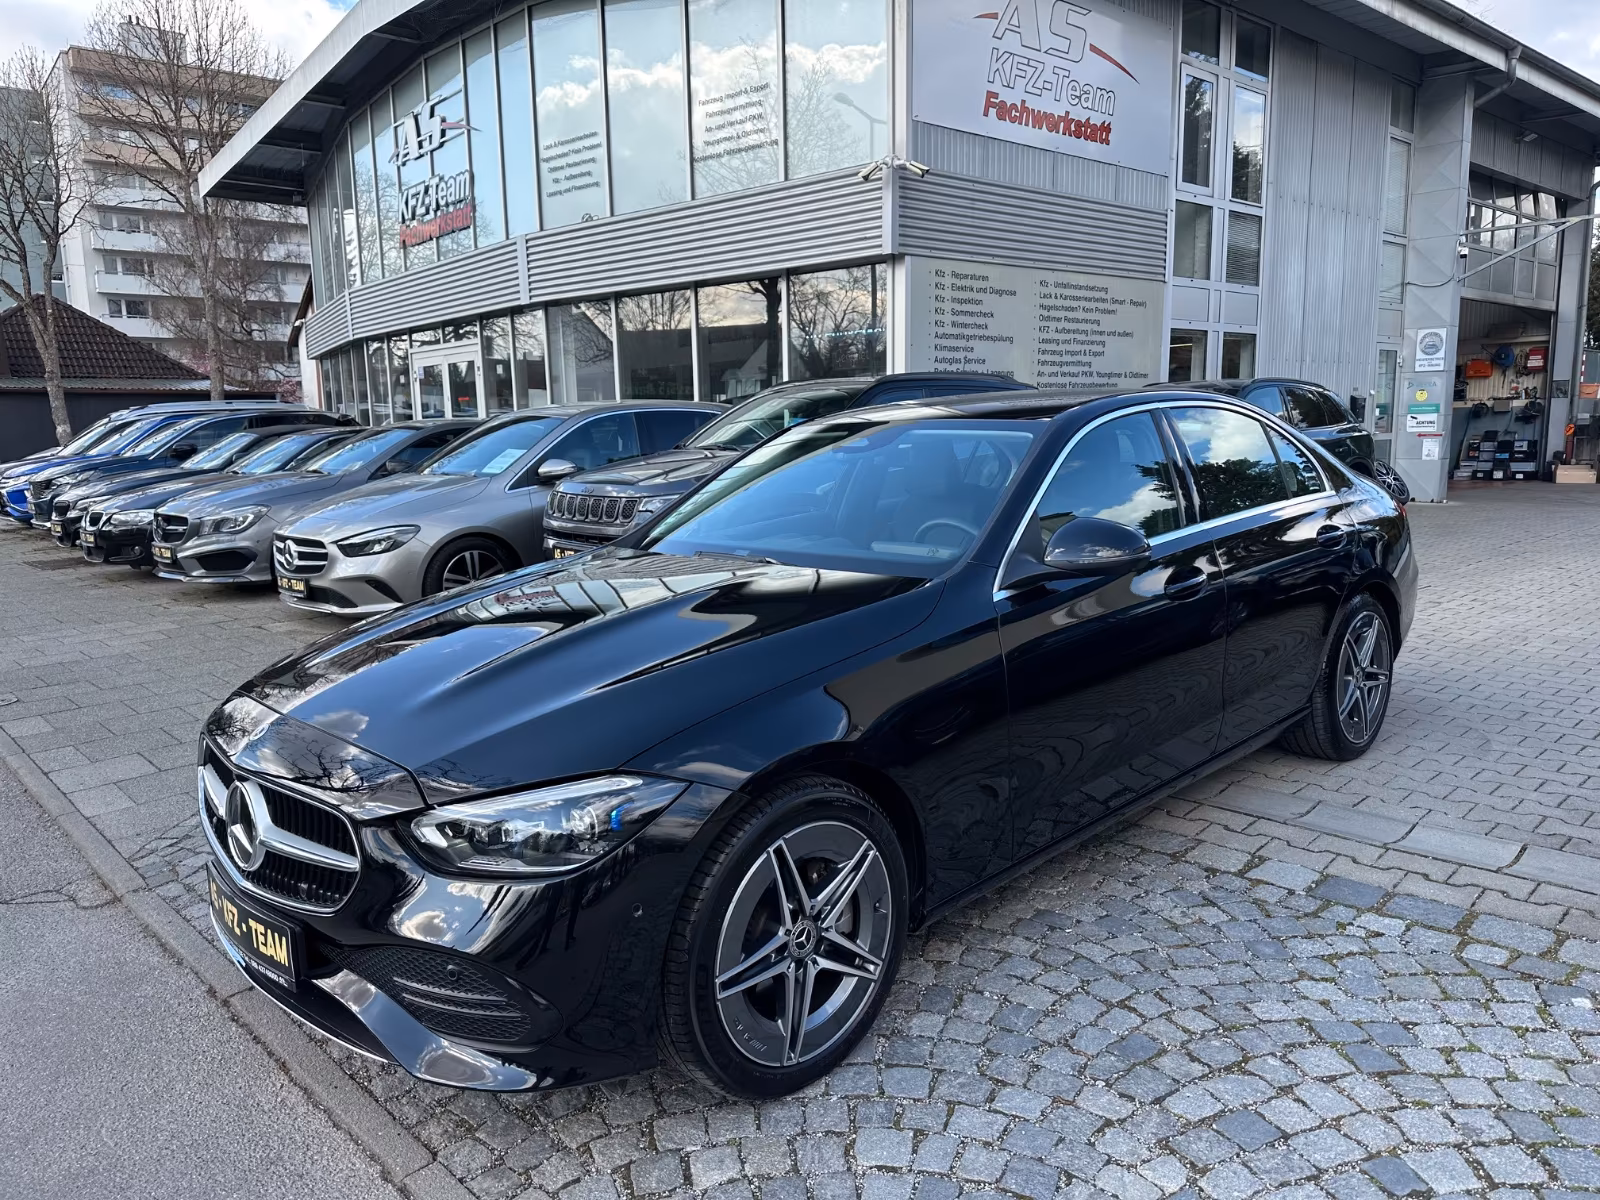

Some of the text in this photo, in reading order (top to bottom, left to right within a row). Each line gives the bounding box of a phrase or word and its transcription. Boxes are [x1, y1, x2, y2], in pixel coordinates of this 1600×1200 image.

[992, 0, 1092, 63] AS
[750, 82, 768, 92] Export
[987, 47, 1116, 116] KFZ-Team
[983, 90, 1112, 145] Fachwerkstatt
[394, 95, 447, 166] AS
[399, 170, 473, 222] KFZ-Team
[400, 203, 474, 247] Fachwerkstatt
[935, 269, 945, 278] Kfz
[951, 270, 989, 281] Reparaturen
[935, 282, 945, 290] Kfz
[951, 283, 974, 292] Elektrik
[989, 287, 1016, 297] Diagnose
[1054, 281, 1108, 294] Unfallinstandsetzung
[935, 294, 945, 303] Kfz
[951, 296, 983, 306] Inspektion
[1060, 293, 1108, 304] Karosseriearbeiten
[1110, 297, 1126, 306] (Smart
[1130, 299, 1147, 308] Repair)
[935, 307, 945, 315] Kfz
[951, 308, 994, 318] Sommercheck
[1039, 303, 1081, 312] Hagelschaden?
[1095, 307, 1117, 315] Problem!
[935, 319, 945, 327] Kfz
[951, 321, 988, 330] Wintercheck
[1039, 314, 1100, 326] Oldtimer Restaurierung
[934, 331, 1013, 344] Automatikgetriebespülung
[1055, 327, 1088, 337] Aufbereitung
[1090, 328, 1106, 336] (innen
[1117, 330, 1134, 339] außen)
[934, 344, 974, 353] Klimaservice
[1038, 337, 1060, 346] Leasing
[1073, 338, 1105, 348] Finanzierung
[1038, 348, 1063, 357] Fahrzeug
[1065, 349, 1082, 357] Import
[934, 356, 986, 365] Autoglas Service
[1037, 359, 1092, 368] Fahrzeugvermittlung
[1096, 371, 1122, 379] Youngtimer
[248, 918, 288, 966] TEAM
